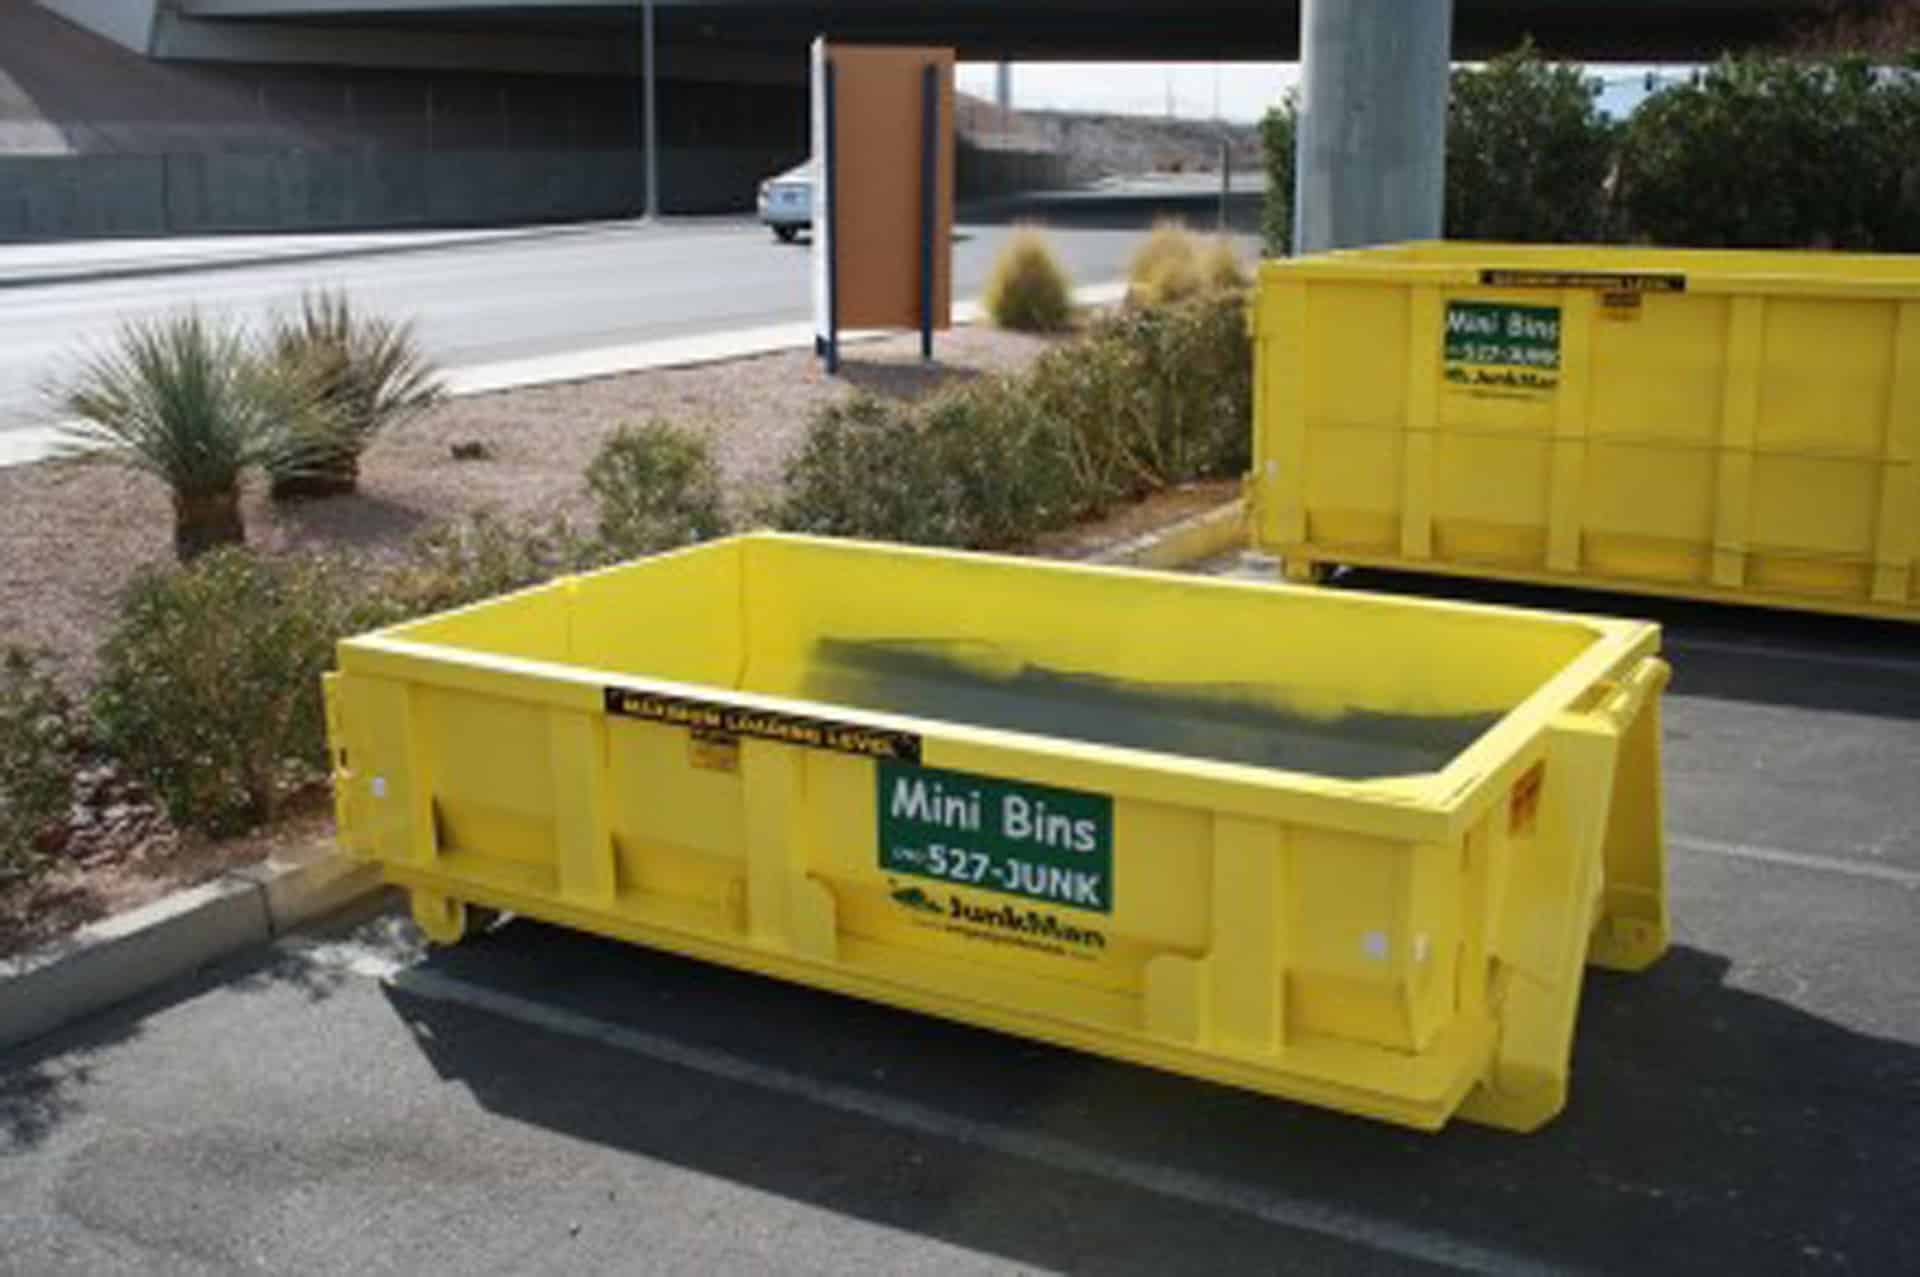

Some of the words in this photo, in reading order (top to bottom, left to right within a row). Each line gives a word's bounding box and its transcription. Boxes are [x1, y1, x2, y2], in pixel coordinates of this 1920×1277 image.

[891, 778, 981, 831] Mini
[1001, 795, 1096, 851] Bins
[926, 844, 1100, 906] 527-JUNK
